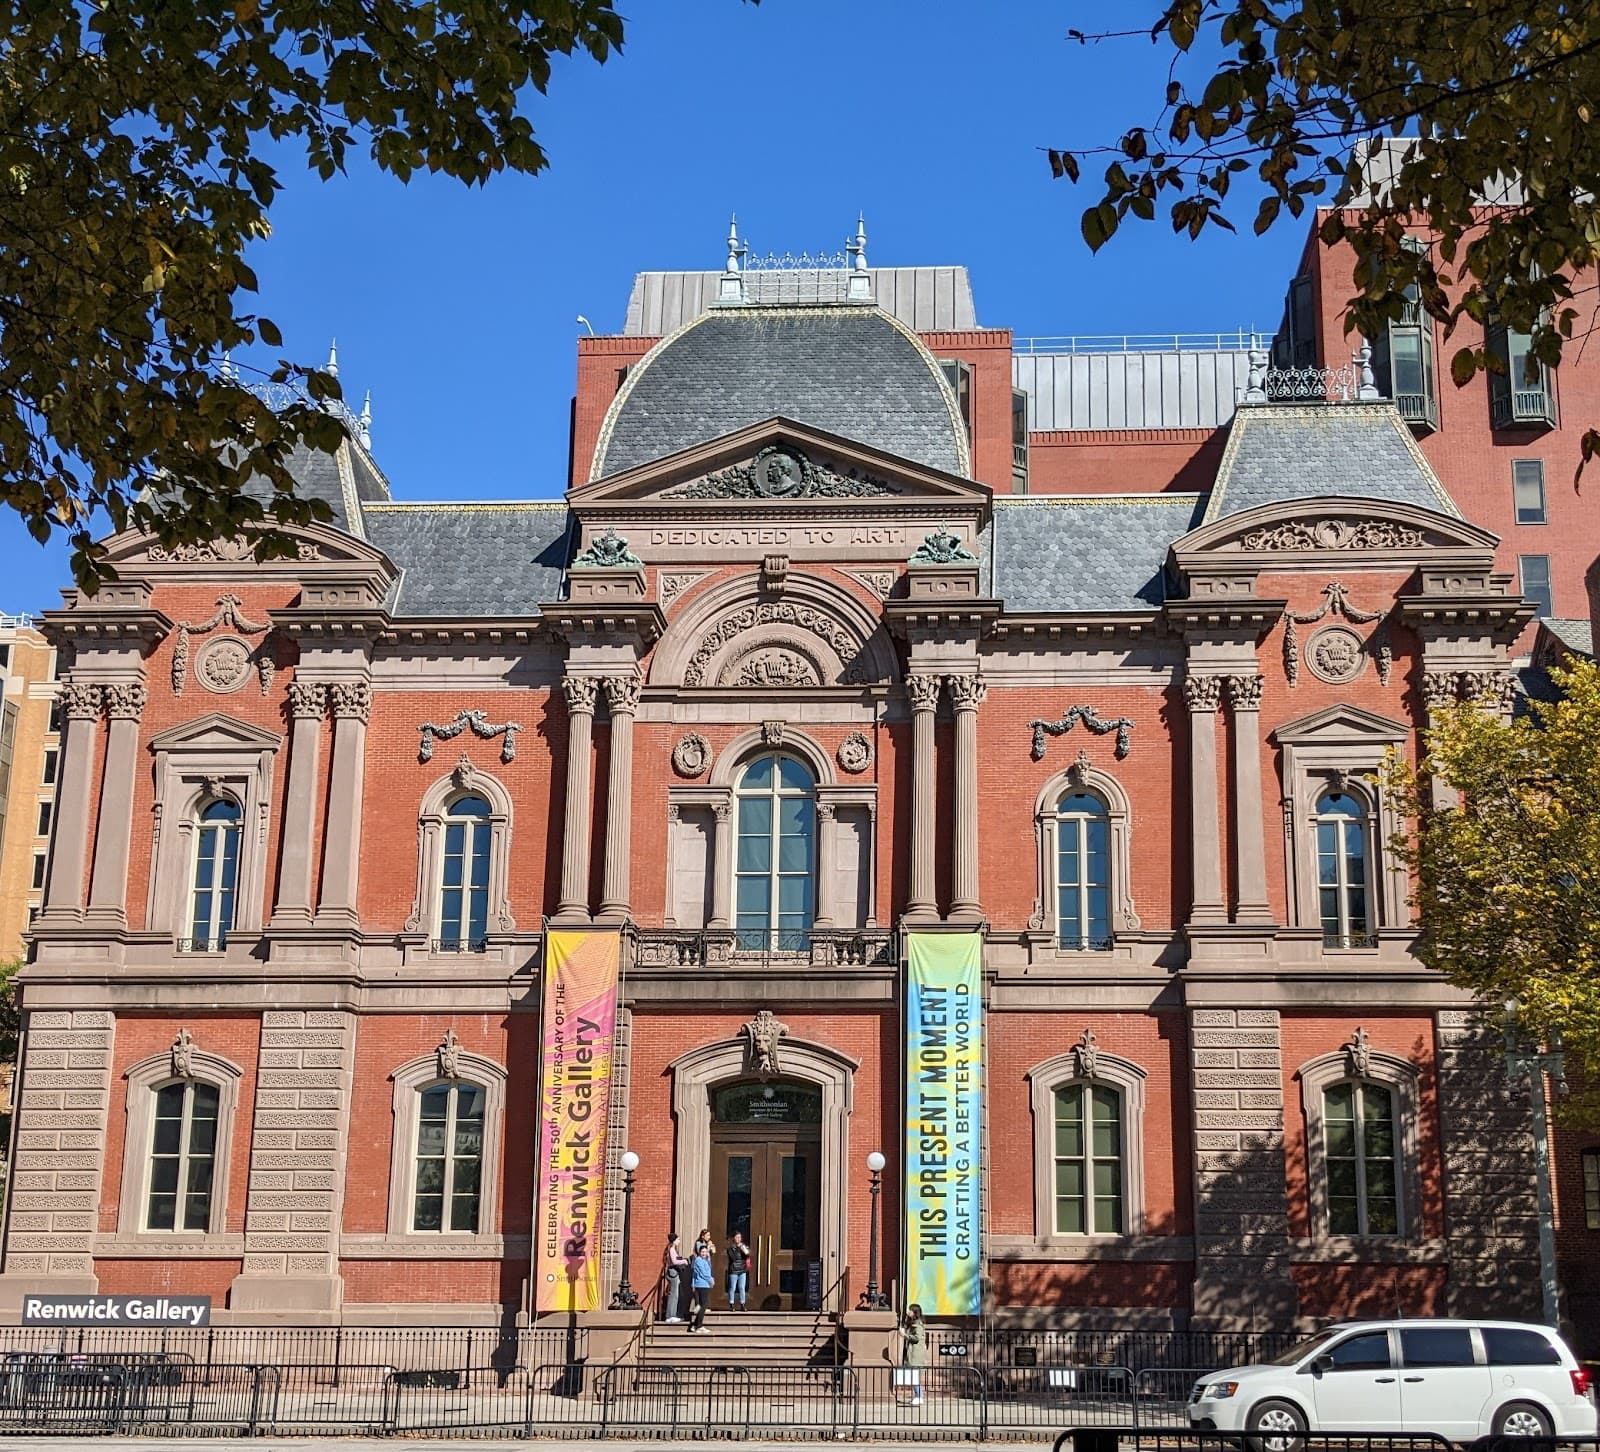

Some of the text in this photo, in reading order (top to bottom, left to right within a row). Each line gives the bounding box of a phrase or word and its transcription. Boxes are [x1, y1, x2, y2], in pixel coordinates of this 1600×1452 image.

[650, 528, 905, 545] DEDICATED TO ART.
[547, 983, 565, 1258] CELEBRATING THE 50th ANNIVERSARY OF THE
[563, 1016, 600, 1257] Renwick Gallery
[590, 1034, 609, 1258] Smithsonian American Art Museum
[920, 984, 947, 1260] THIS PRESENT MOMENT
[956, 983, 970, 1260] CRAFTING A BETTER WORLD
[26, 1299, 205, 1326] Renwick Gallery
